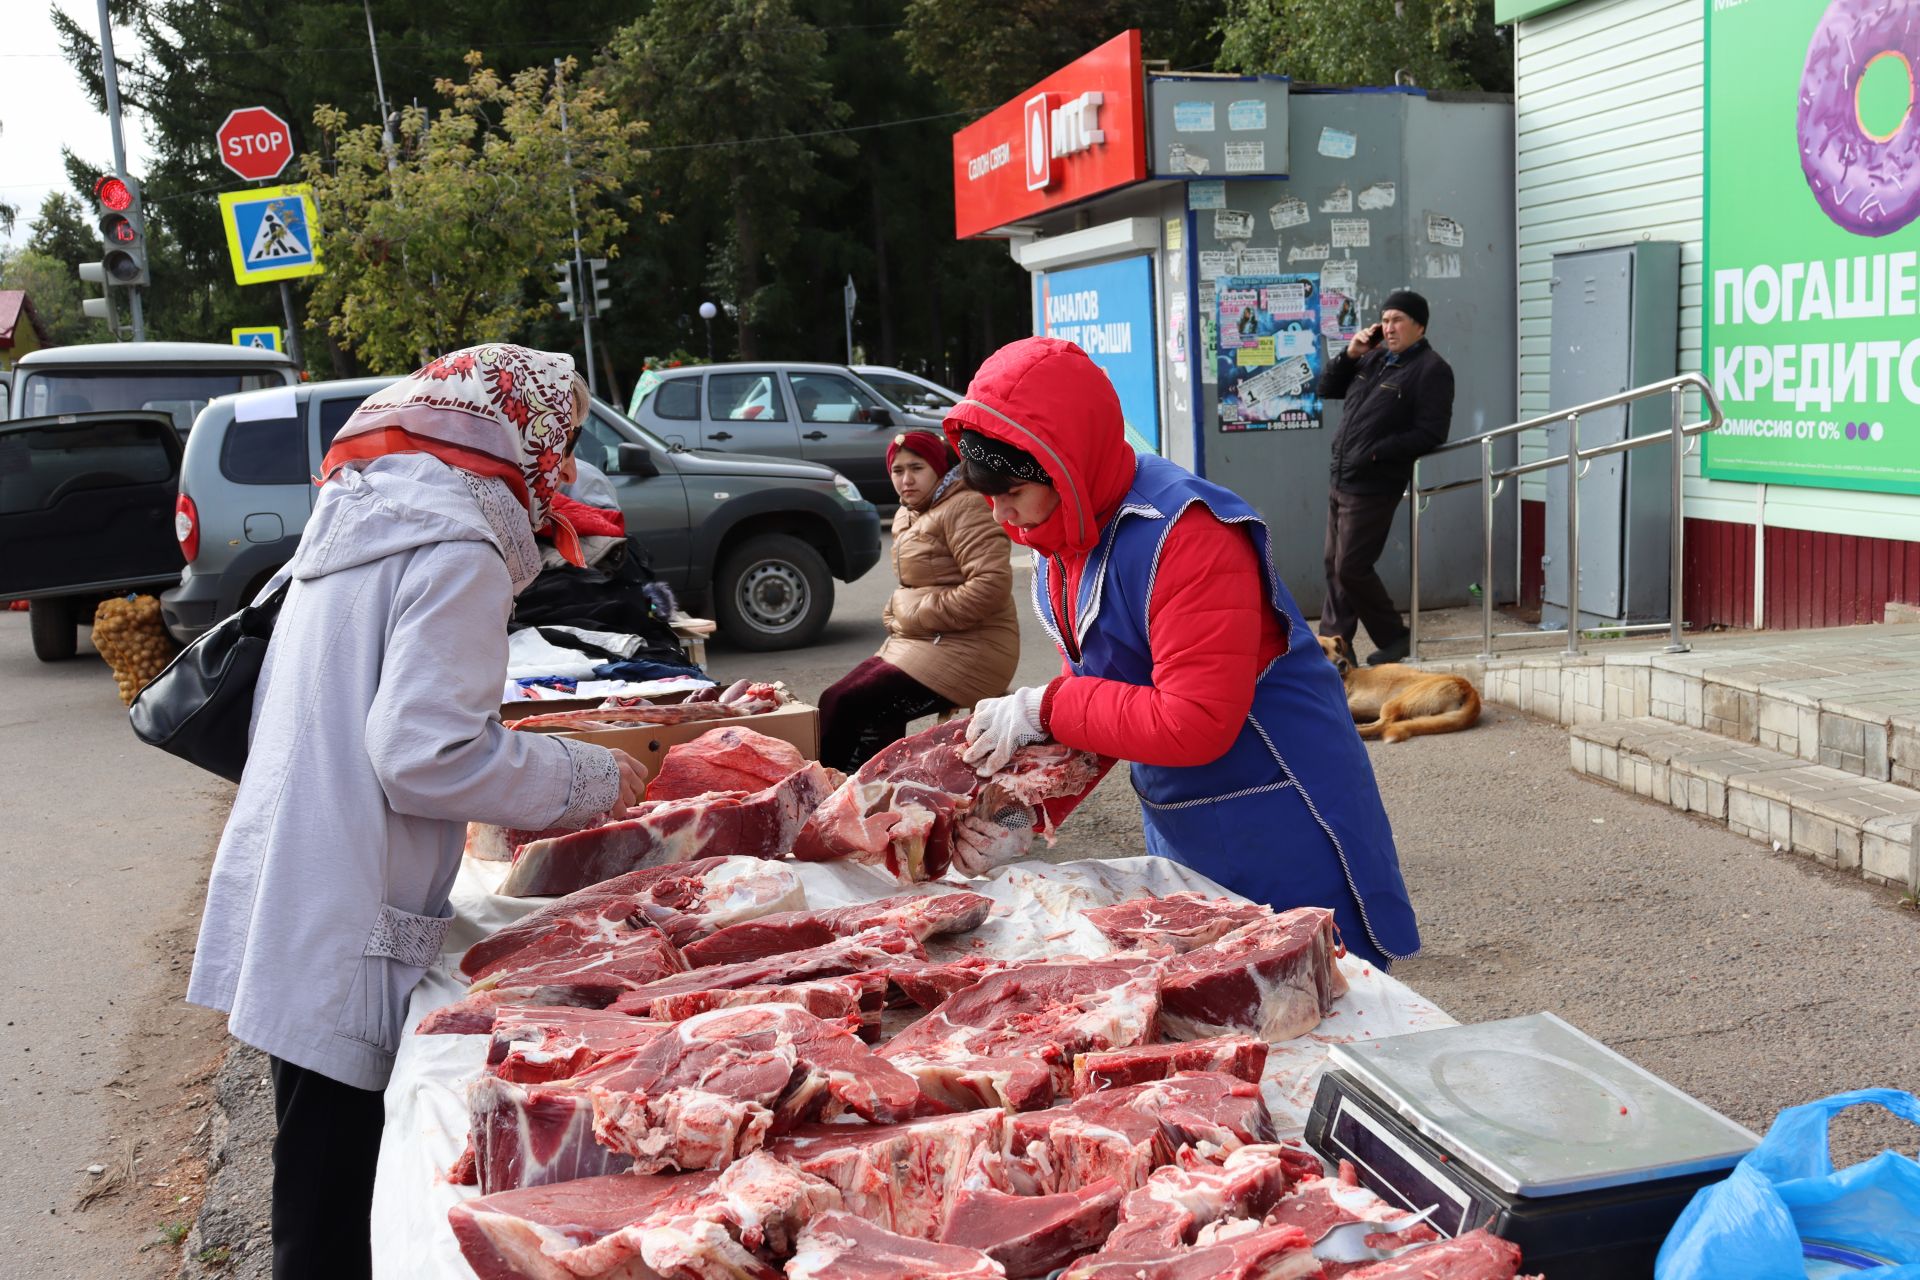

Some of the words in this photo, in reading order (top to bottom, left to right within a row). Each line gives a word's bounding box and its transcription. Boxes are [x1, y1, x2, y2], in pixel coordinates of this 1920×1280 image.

[1051, 91, 1104, 159] МТС
[228, 131, 283, 157] STOP
[1714, 251, 1920, 326] ПОГАШЕ
[1046, 290, 1099, 324] КАНАЛОВ
[1082, 322, 1132, 354] КРЫШИ
[1300, 362, 1310, 375] 3
[1247, 390, 1257, 402] 1
[1795, 421, 1816, 438] ОТ
[1820, 421, 1840, 440] 0%
